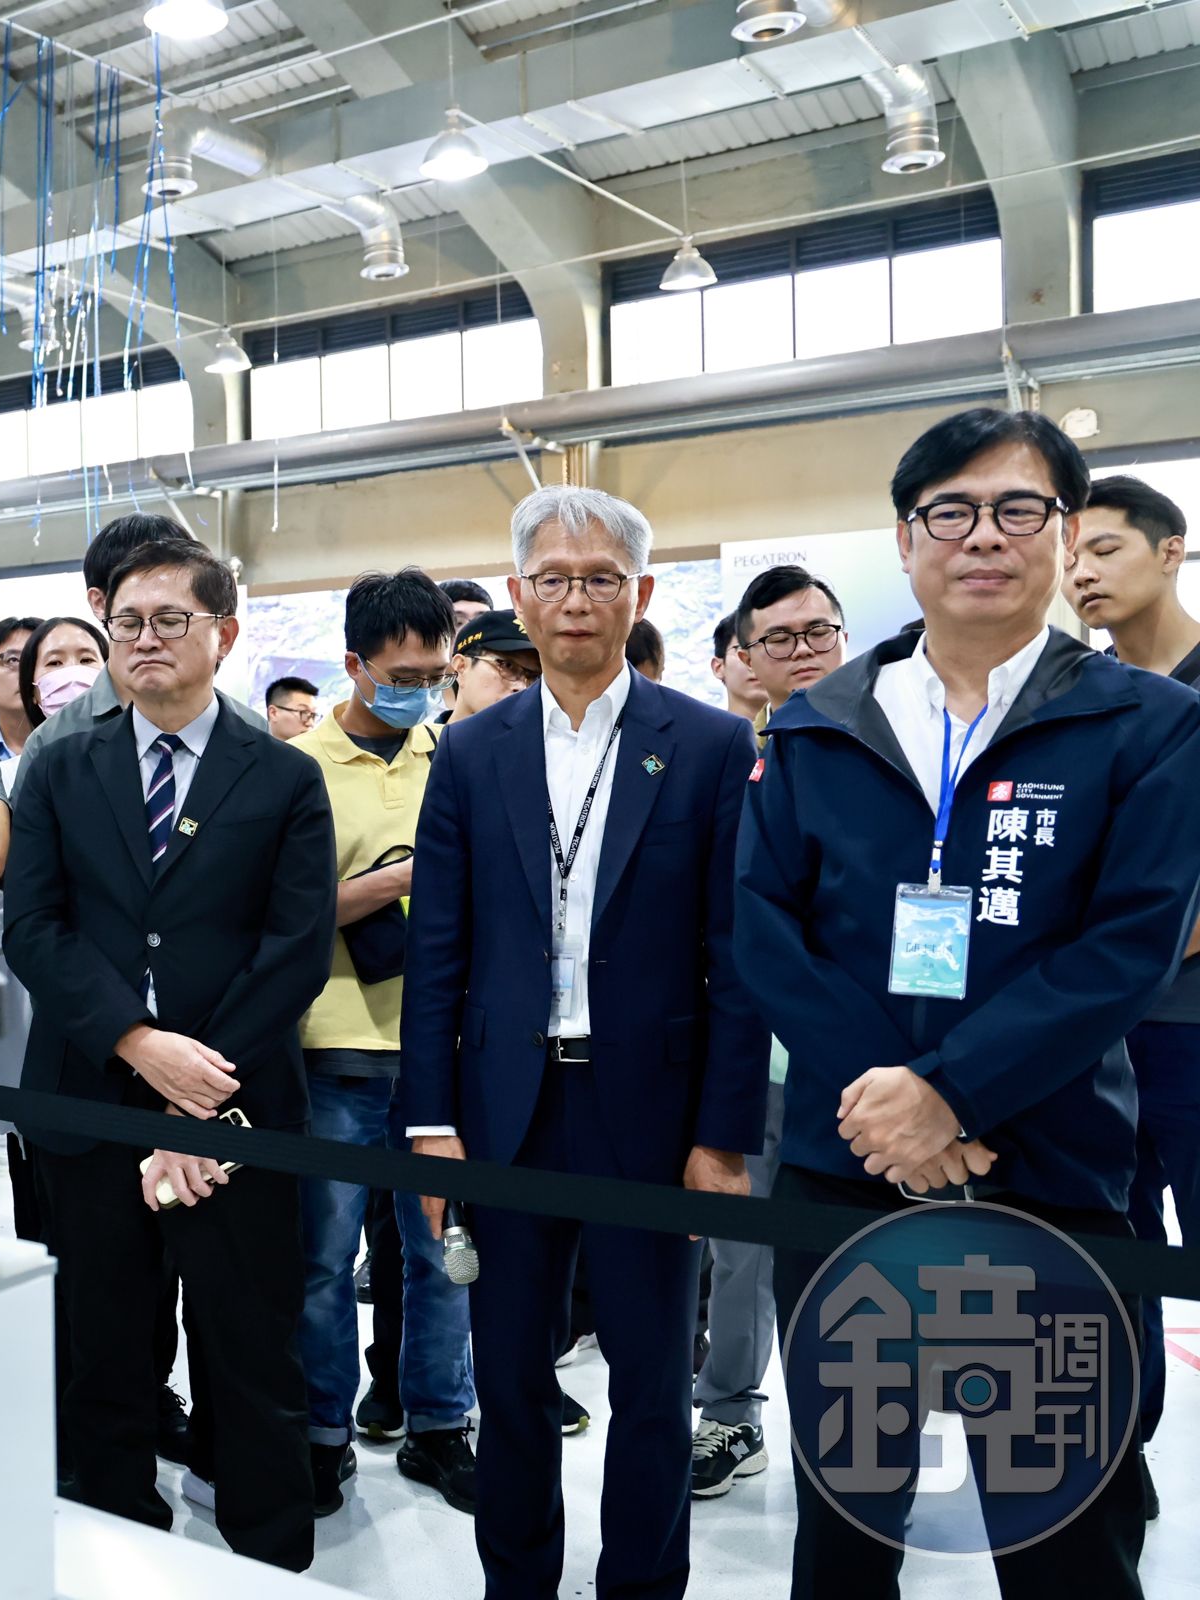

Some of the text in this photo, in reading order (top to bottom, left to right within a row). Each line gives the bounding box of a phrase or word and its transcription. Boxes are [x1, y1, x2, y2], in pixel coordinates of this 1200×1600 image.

[734, 551, 807, 567] PEGATRON
[1017, 783, 1065, 791] KAOHSIUNG
[577, 796, 593, 829] PEGATRON
[1033, 808, 1058, 847] 市長
[549, 822, 562, 855] PEGATRON
[566, 835, 581, 867] PEGATRON
[976, 807, 1030, 926] 陳其邁
